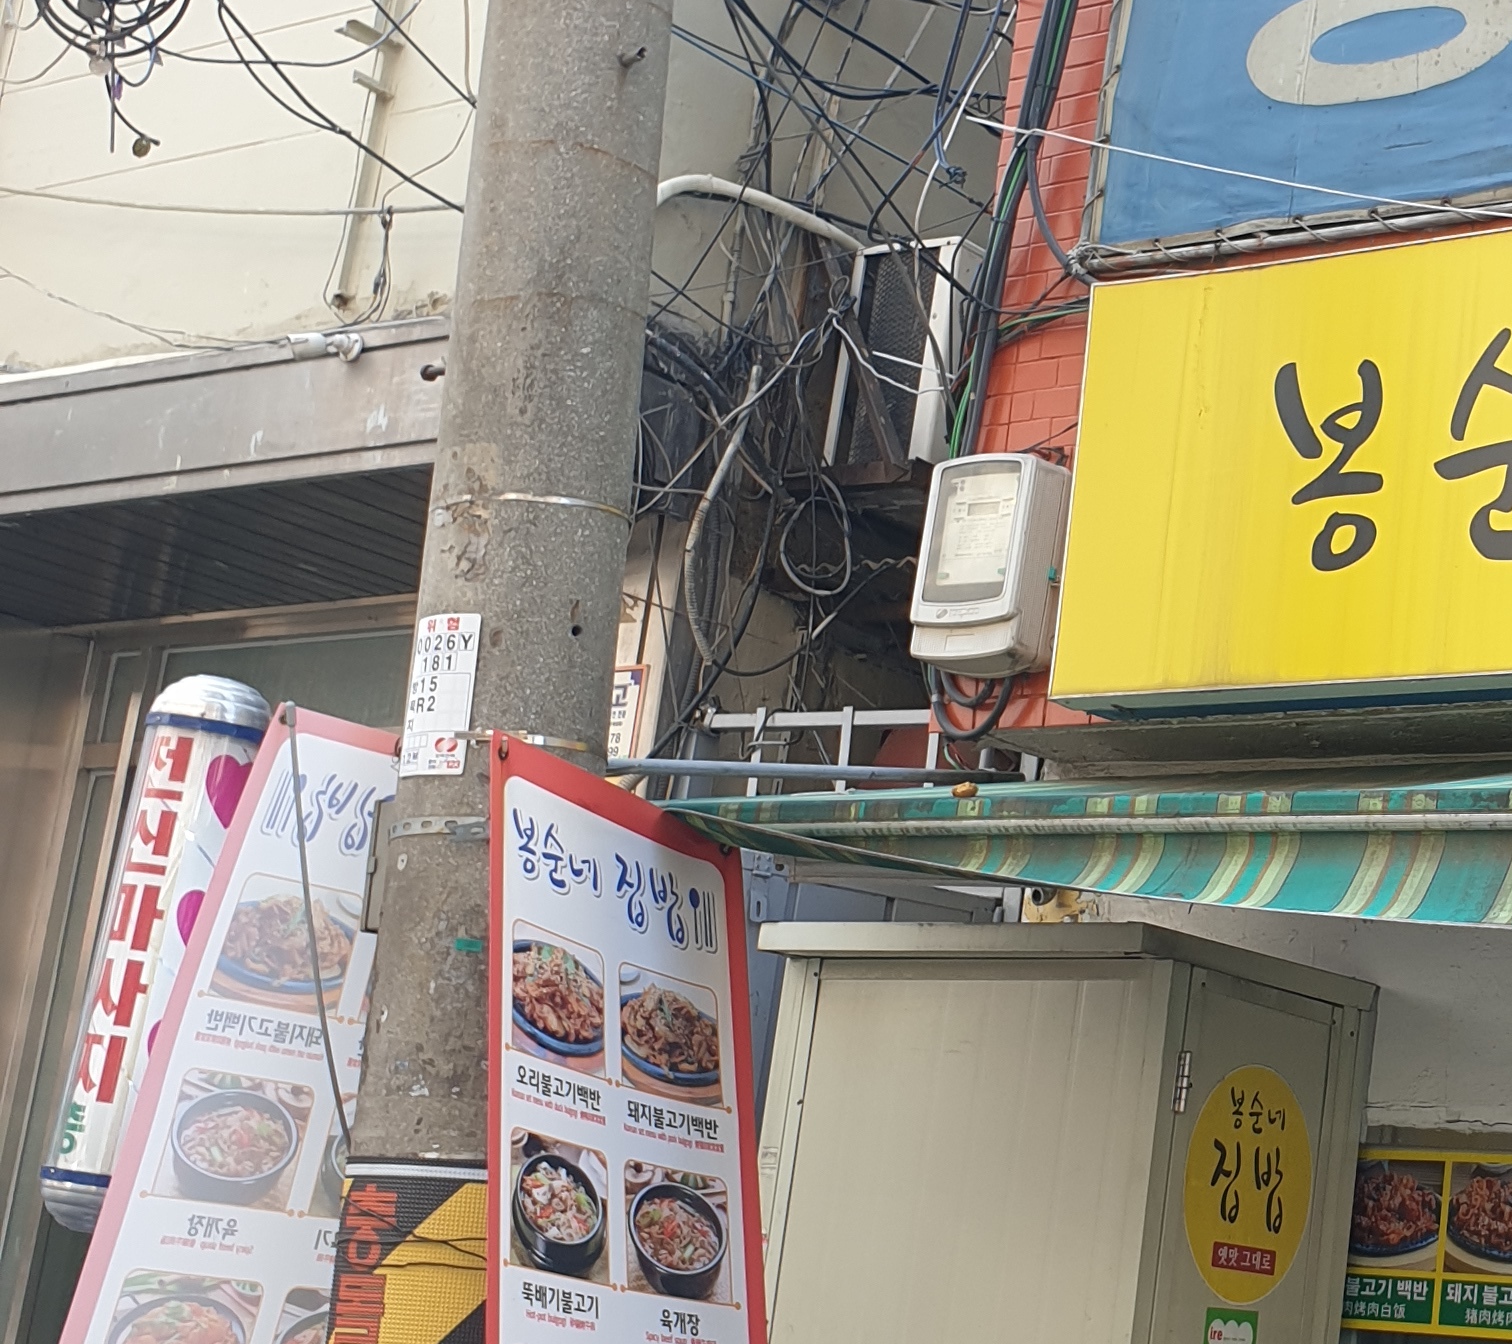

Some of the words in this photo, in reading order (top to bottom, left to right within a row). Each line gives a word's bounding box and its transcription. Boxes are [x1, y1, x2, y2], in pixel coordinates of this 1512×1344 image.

[422, 654, 453, 672] 181
[512, 807, 599, 892] 봉순네
[614, 851, 686, 945] 집밥
[515, 1064, 602, 1113] 오리불고기백반
[626, 1099, 720, 1141] 돼지불고기백반
[1230, 1086, 1287, 1134] 봉순네
[1210, 1138, 1283, 1234] 집밥
[1240, 1250, 1272, 1272] 그대로
[521, 1281, 600, 1320] 뚝배기불고기
[1396, 1280, 1429, 1301] 백반
[1446, 1282, 1478, 1305] 돼지
[659, 1308, 701, 1337] 육개장
